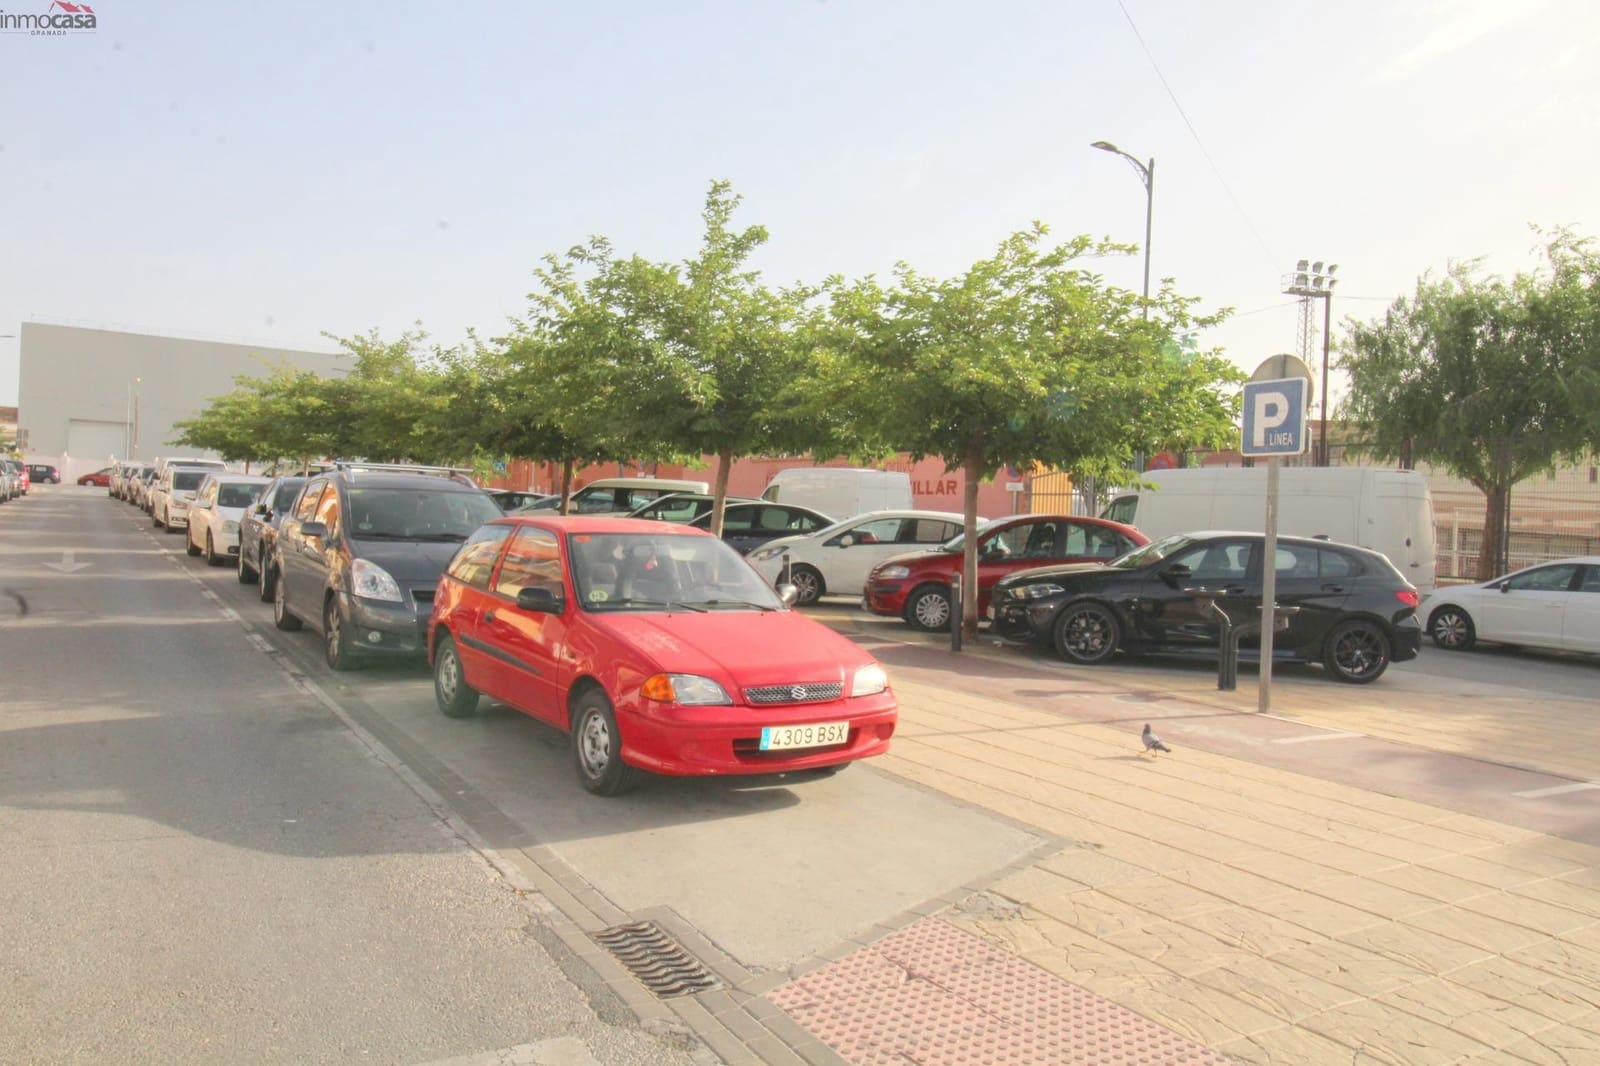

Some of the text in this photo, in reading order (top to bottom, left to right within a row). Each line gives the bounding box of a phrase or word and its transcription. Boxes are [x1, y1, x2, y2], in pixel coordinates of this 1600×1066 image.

[1253, 392, 1289, 447] P
[911, 480, 957, 495] ILLAR
[772, 724, 846, 746] 4309 BSX
